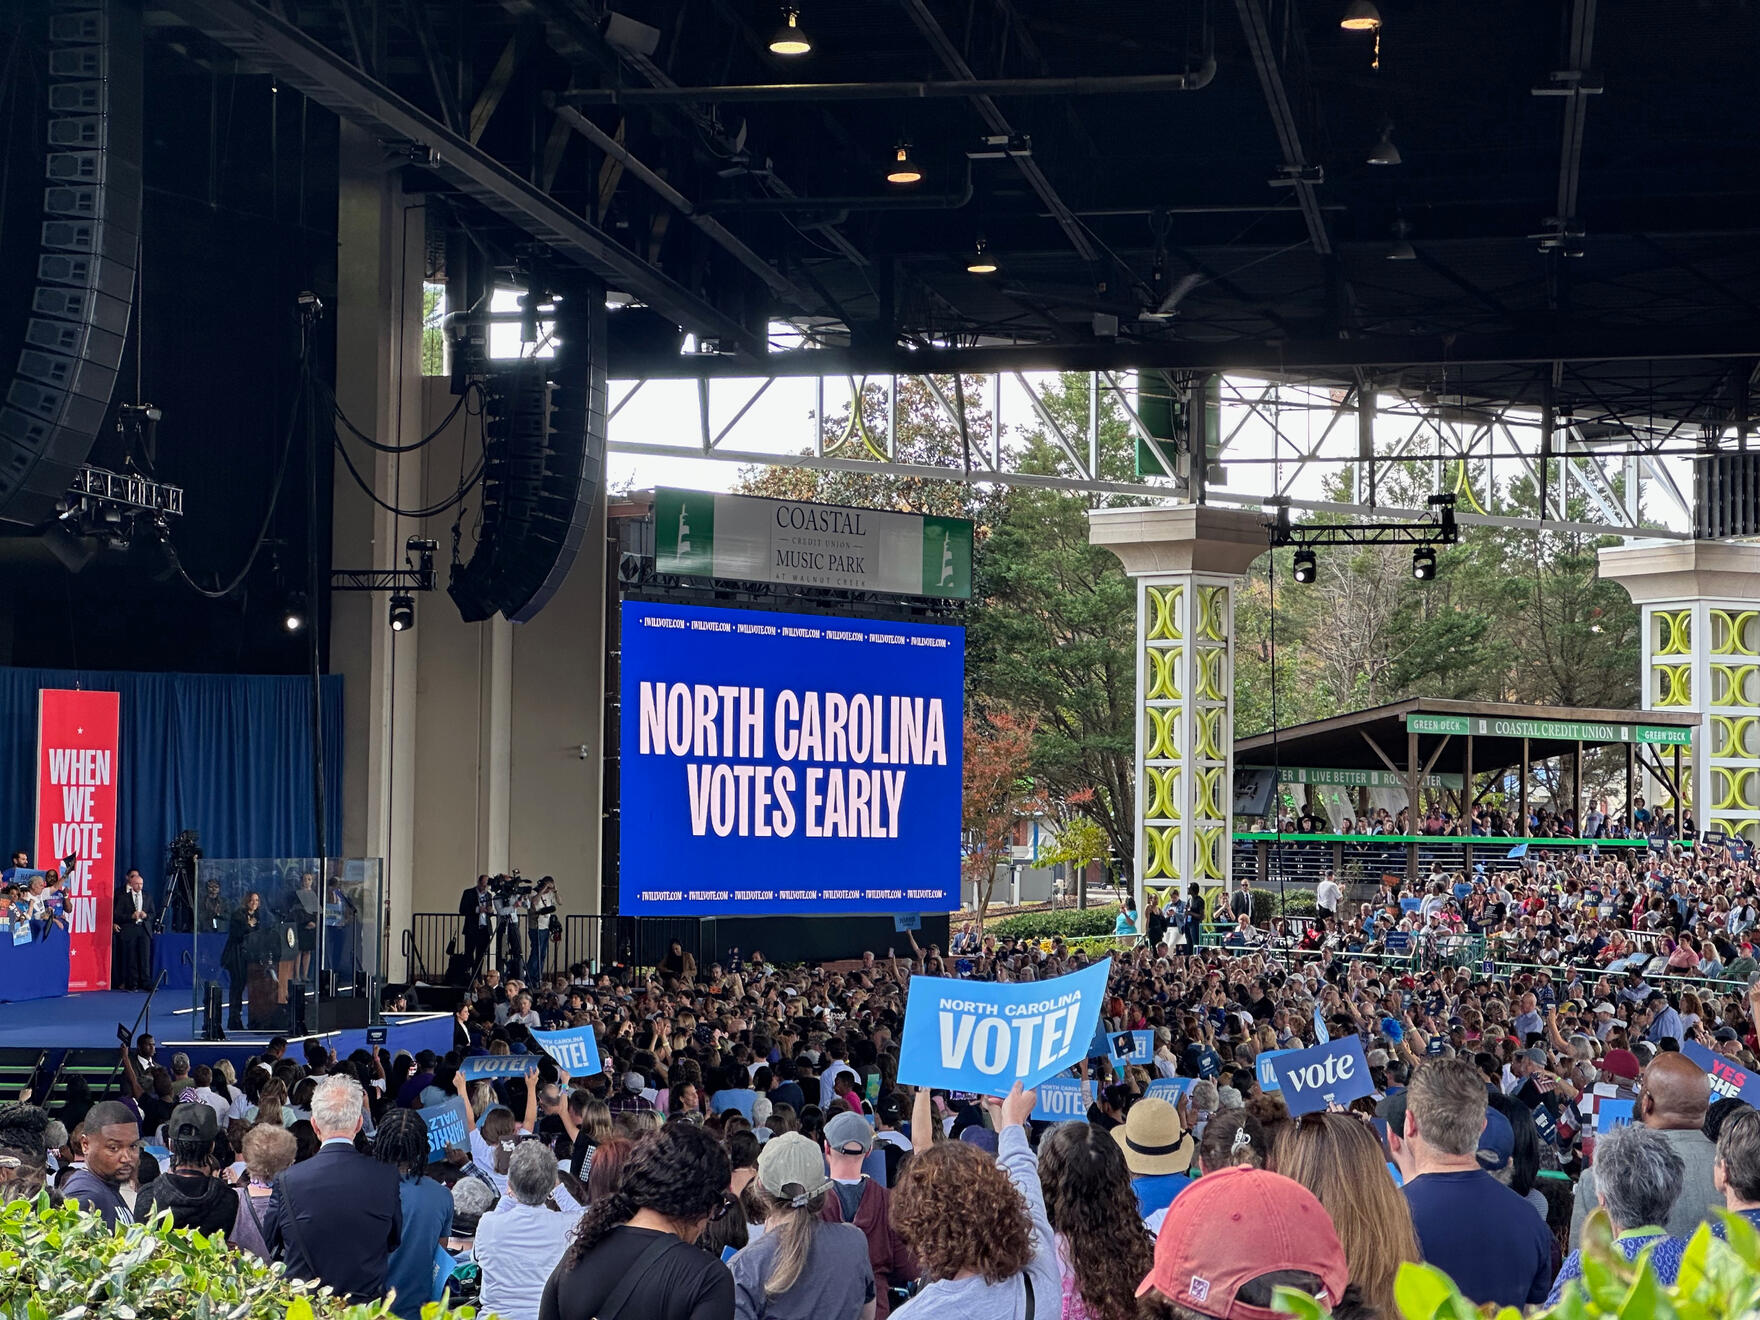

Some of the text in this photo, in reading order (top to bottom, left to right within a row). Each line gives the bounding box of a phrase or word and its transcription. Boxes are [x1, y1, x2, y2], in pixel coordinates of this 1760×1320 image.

[776, 505, 866, 536] COASTAL
[791, 536, 851, 549] CREDIT UNION
[776, 549, 865, 574] MUSIC PARK
[775, 572, 786, 581] AT
[792, 574, 831, 585] WALNUT
[639, 681, 947, 766] NORTH CAROLINA
[1413, 719, 1460, 730] GREEN DECK
[1495, 721, 1614, 739] COASTAL CREDIT UNION
[1644, 730, 1686, 741] GREEN DECK
[48, 748, 111, 785] WHEN
[1311, 769, 1331, 782] LIVE
[1333, 771, 1367, 784] BETTER
[62, 786, 95, 823] WE
[686, 763, 906, 838] VOTES EARLY
[52, 822, 103, 860] VOTE
[939, 989, 1082, 1016] NORTH CAROLINA
[938, 1001, 1081, 1078] VOTE!
[472, 1058, 529, 1073] VOTE!
[1286, 1053, 1355, 1093] vote
[1712, 1059, 1747, 1088] YES
[1708, 1072, 1741, 1098] SHE
[428, 1109, 459, 1131] WALZ
[426, 1120, 466, 1153] HARRIS
